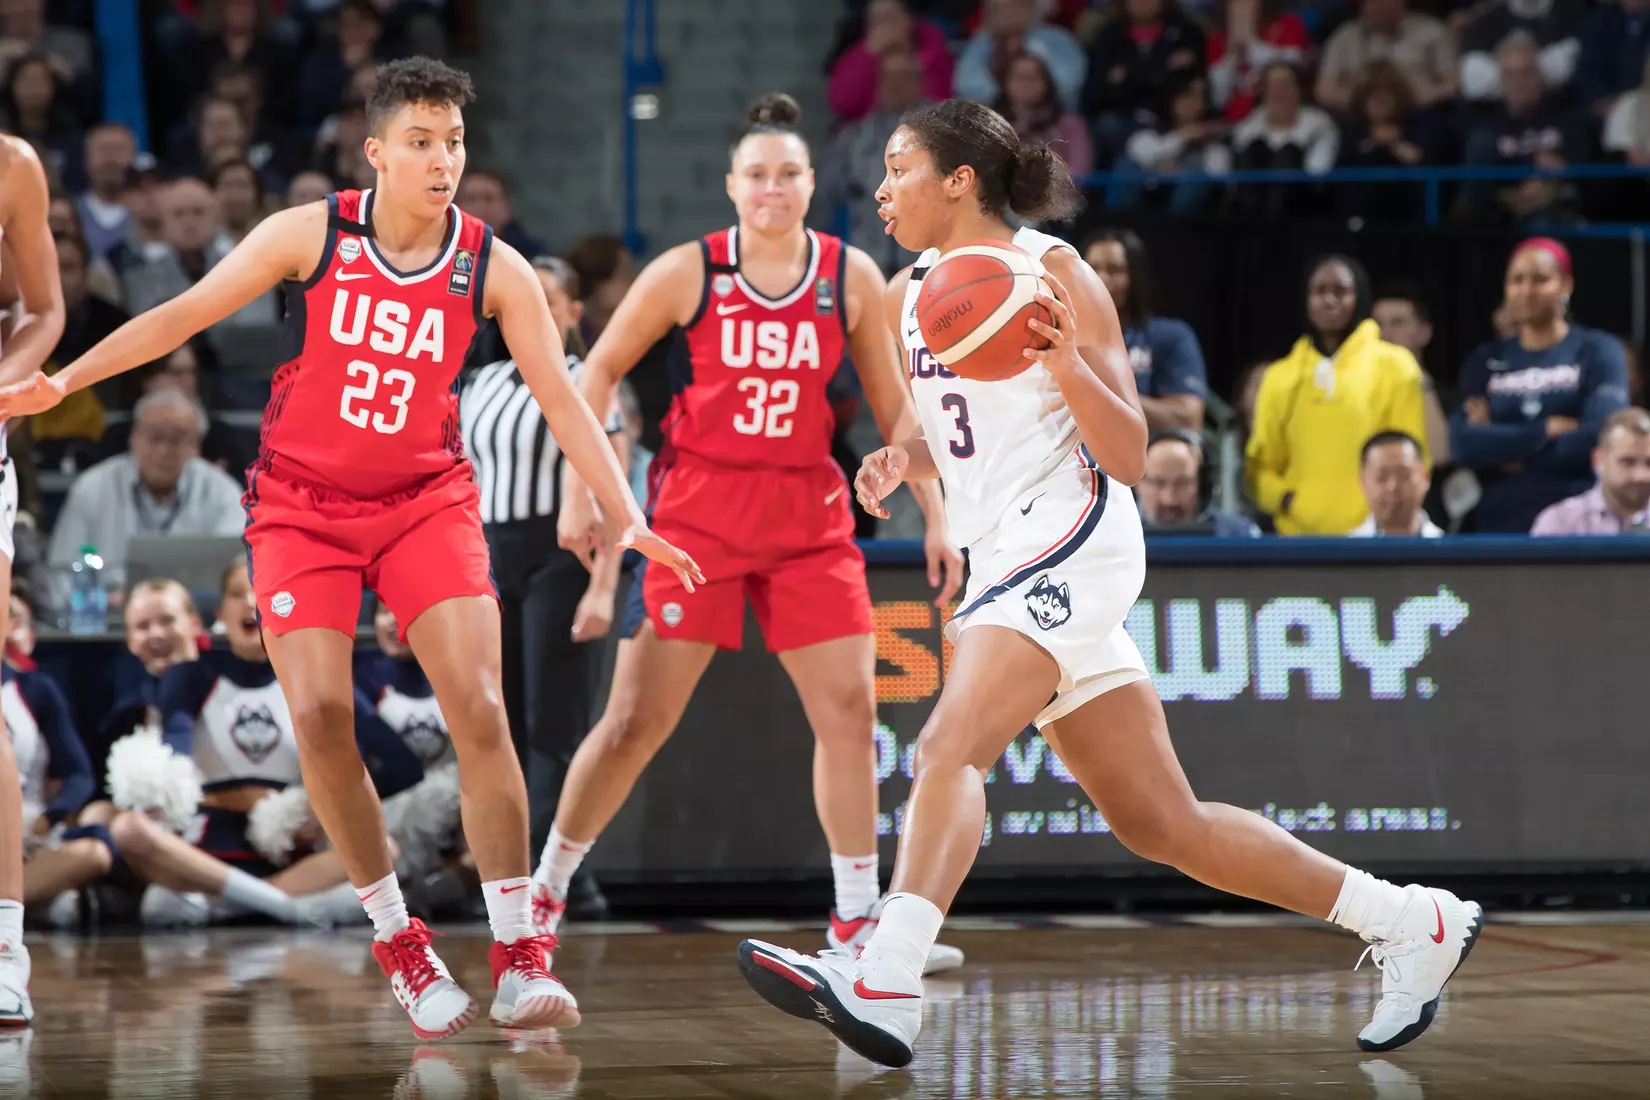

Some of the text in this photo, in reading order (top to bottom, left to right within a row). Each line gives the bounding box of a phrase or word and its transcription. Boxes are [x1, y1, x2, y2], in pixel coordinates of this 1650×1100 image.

[329, 288, 444, 363] USA
[721, 318, 820, 369] USA
[927, 300, 973, 337] molten
[339, 359, 416, 434] 23
[733, 377, 799, 438] 32
[940, 392, 976, 459] 3
